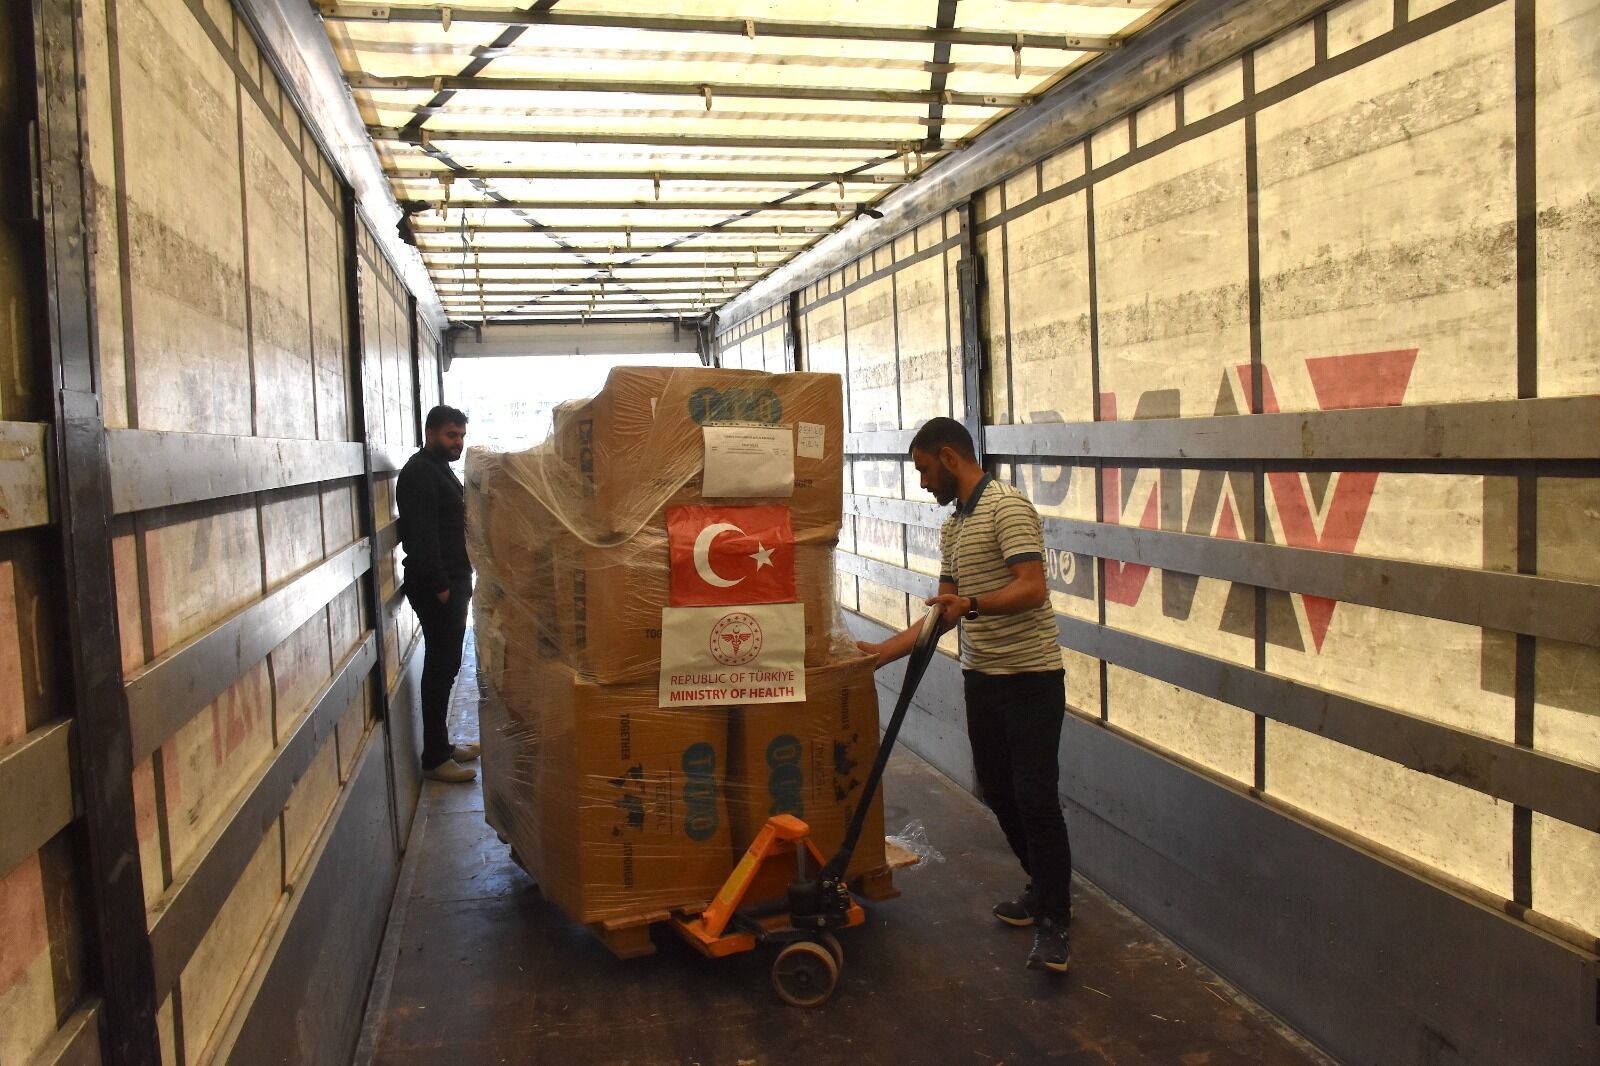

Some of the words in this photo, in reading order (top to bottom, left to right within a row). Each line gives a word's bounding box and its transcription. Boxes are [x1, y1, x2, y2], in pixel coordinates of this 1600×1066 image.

[670, 673, 726, 685] REPUBLIC
[730, 672, 746, 684] OF
[669, 688, 727, 701] MINISTRY
[730, 687, 746, 699] OF
[749, 686, 794, 698] HEALTH
